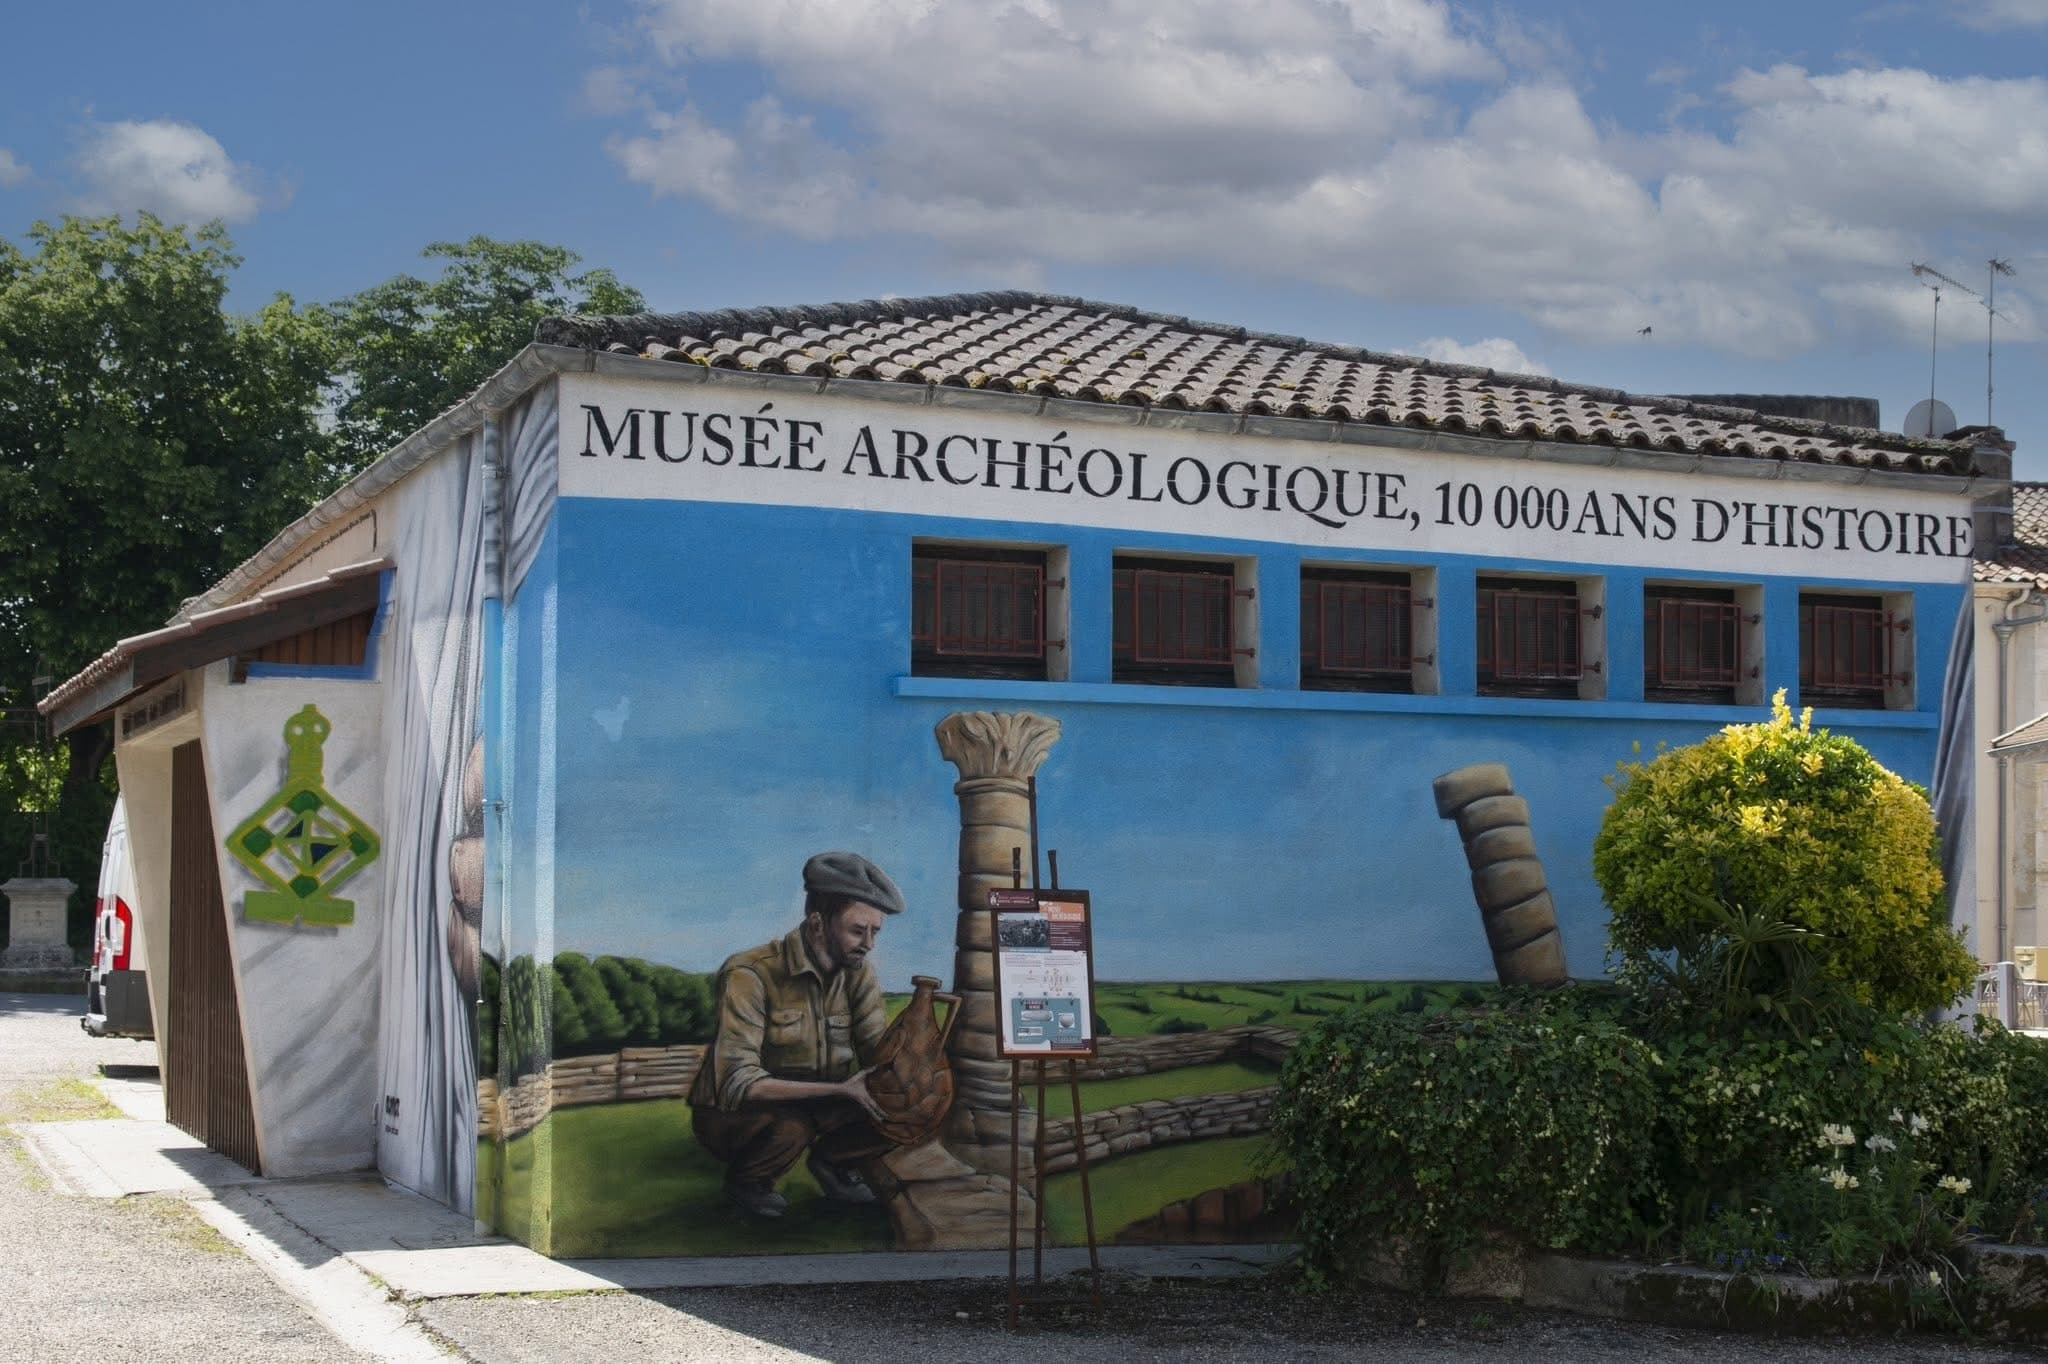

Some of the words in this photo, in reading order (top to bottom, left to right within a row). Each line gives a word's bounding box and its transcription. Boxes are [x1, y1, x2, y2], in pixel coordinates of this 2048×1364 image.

[579, 402, 827, 473] MUSÉE
[842, 425, 1421, 532] ARCHÉOLOGIQUE,
[1434, 481, 1483, 527] 10
[1691, 498, 1975, 558] D'HISTOIRE
